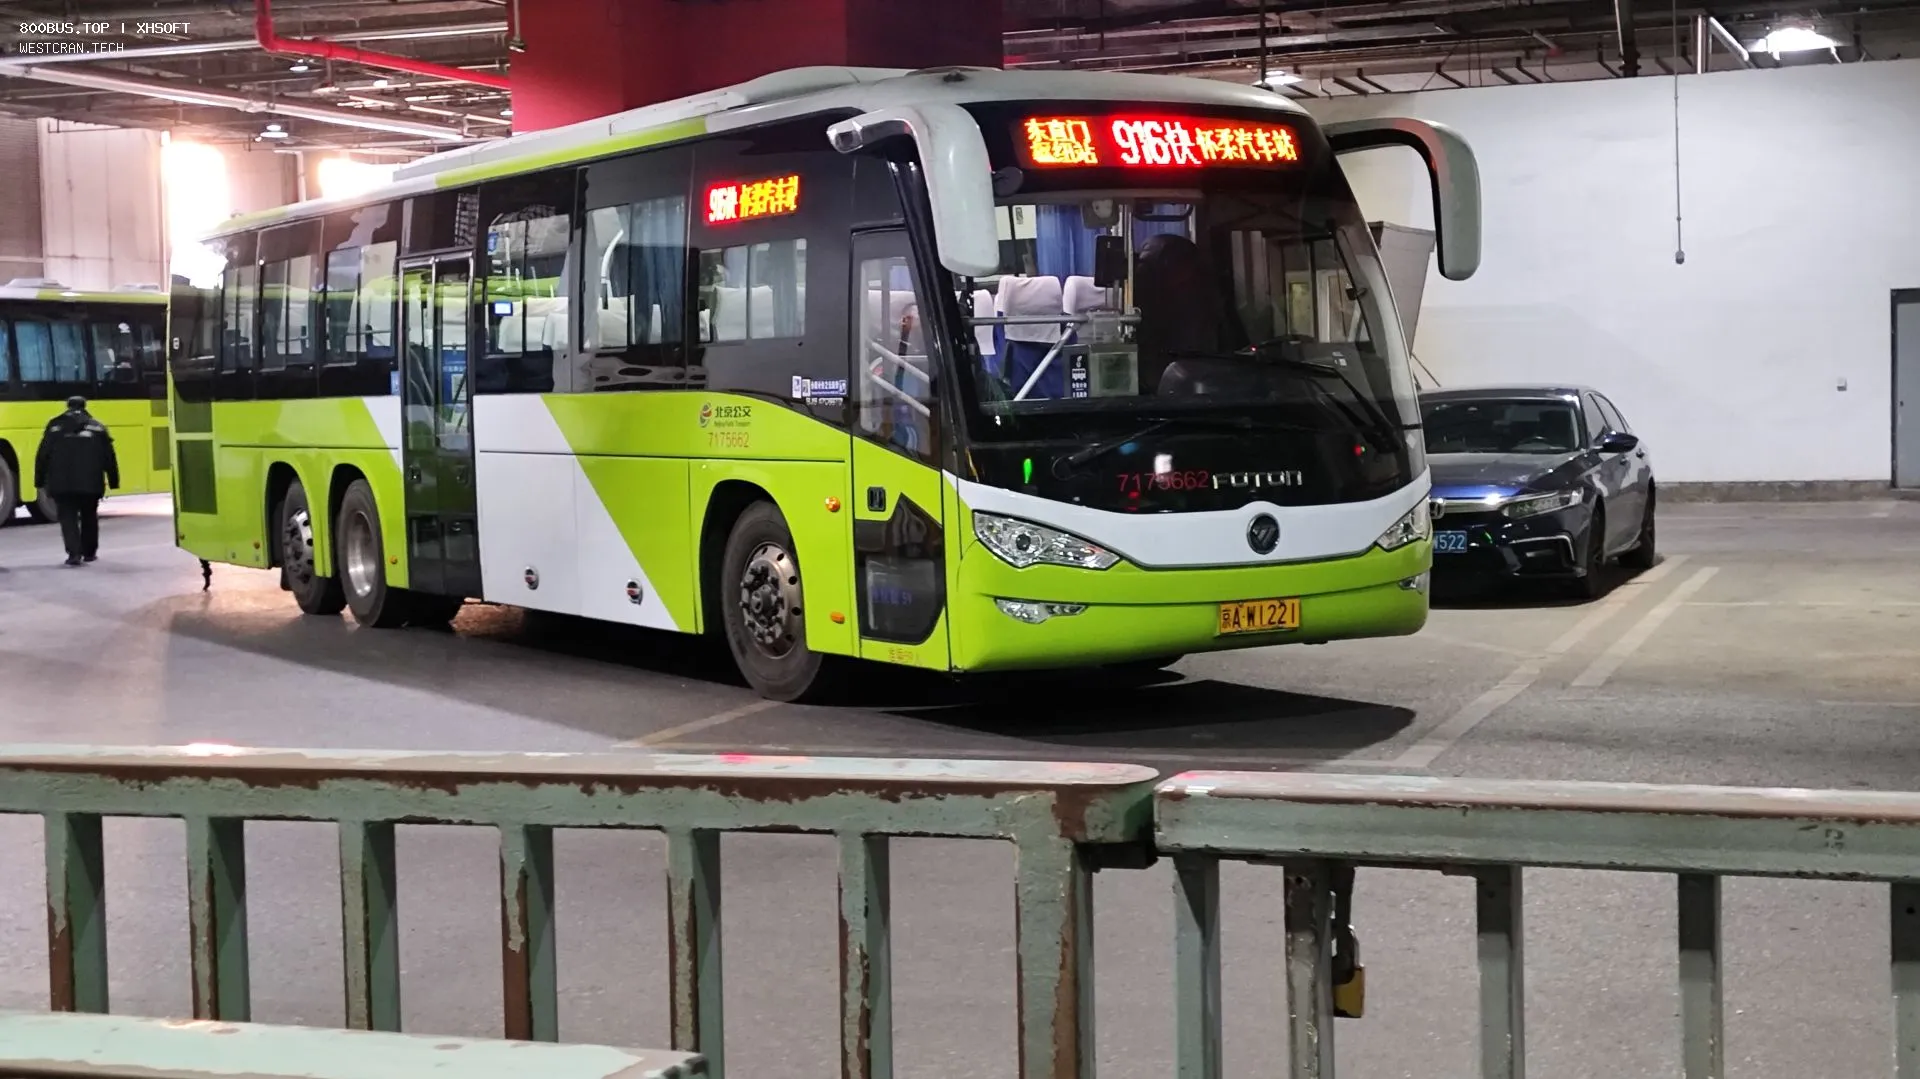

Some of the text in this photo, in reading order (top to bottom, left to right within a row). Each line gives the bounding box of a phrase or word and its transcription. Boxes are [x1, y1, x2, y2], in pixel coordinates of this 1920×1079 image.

[1024, 118, 1092, 143] 东直门
[1111, 120, 1298, 165] 916快 怀柔汽车站
[714, 405, 752, 418] 北京公交
[707, 431, 750, 448] 7175662
[1116, 470, 1209, 492] 7175662
